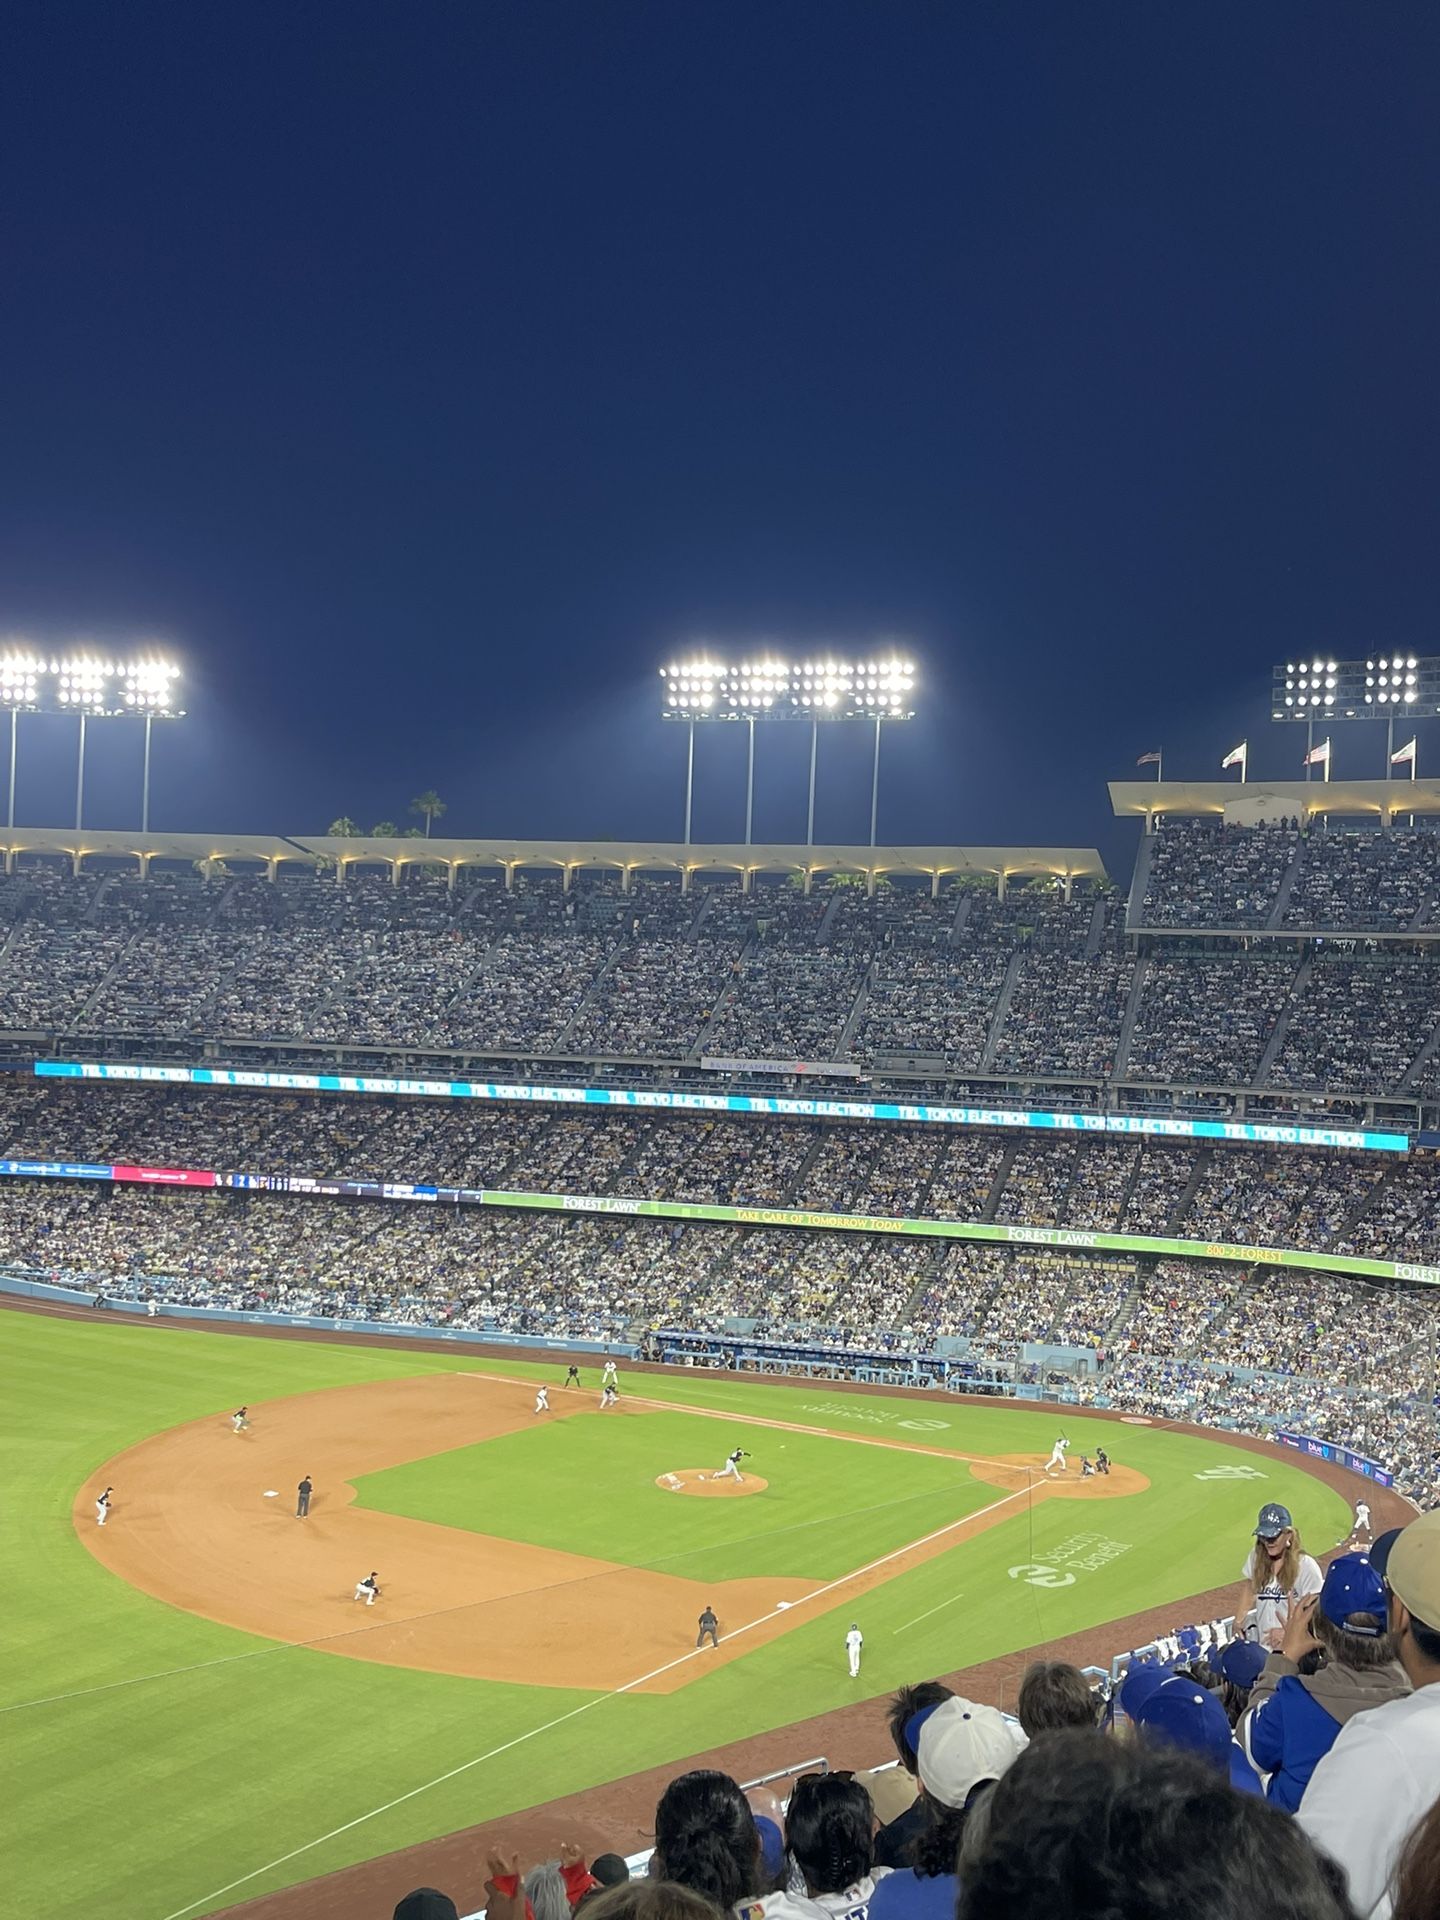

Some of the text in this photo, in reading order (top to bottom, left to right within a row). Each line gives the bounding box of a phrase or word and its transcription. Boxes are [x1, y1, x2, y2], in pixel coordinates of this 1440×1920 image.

[750, 1063, 789, 1072] AMERICA
[750, 1098, 874, 1117] TEL TOKYO ELECTRON
[898, 1106, 1029, 1126] TEL TOKYO ELECTRON
[1053, 1114, 1193, 1135] TEL TOKYO ELECTRON
[1224, 1124, 1364, 1147] TEL TOKYO ELECTRON
[563, 1196, 604, 1211] FOREST
[736, 1210, 905, 1230] TAKE CARE OF TOMORROW TODAY
[1008, 1228, 1054, 1244] FOREST
[1206, 1245, 1285, 1262] 800-2-FOREST
[1395, 1263, 1440, 1284] FOREST
[1308, 1441, 1323, 1453] blue
[1031, 1530, 1109, 1564] Security
[1065, 1541, 1133, 1571] Benefit
